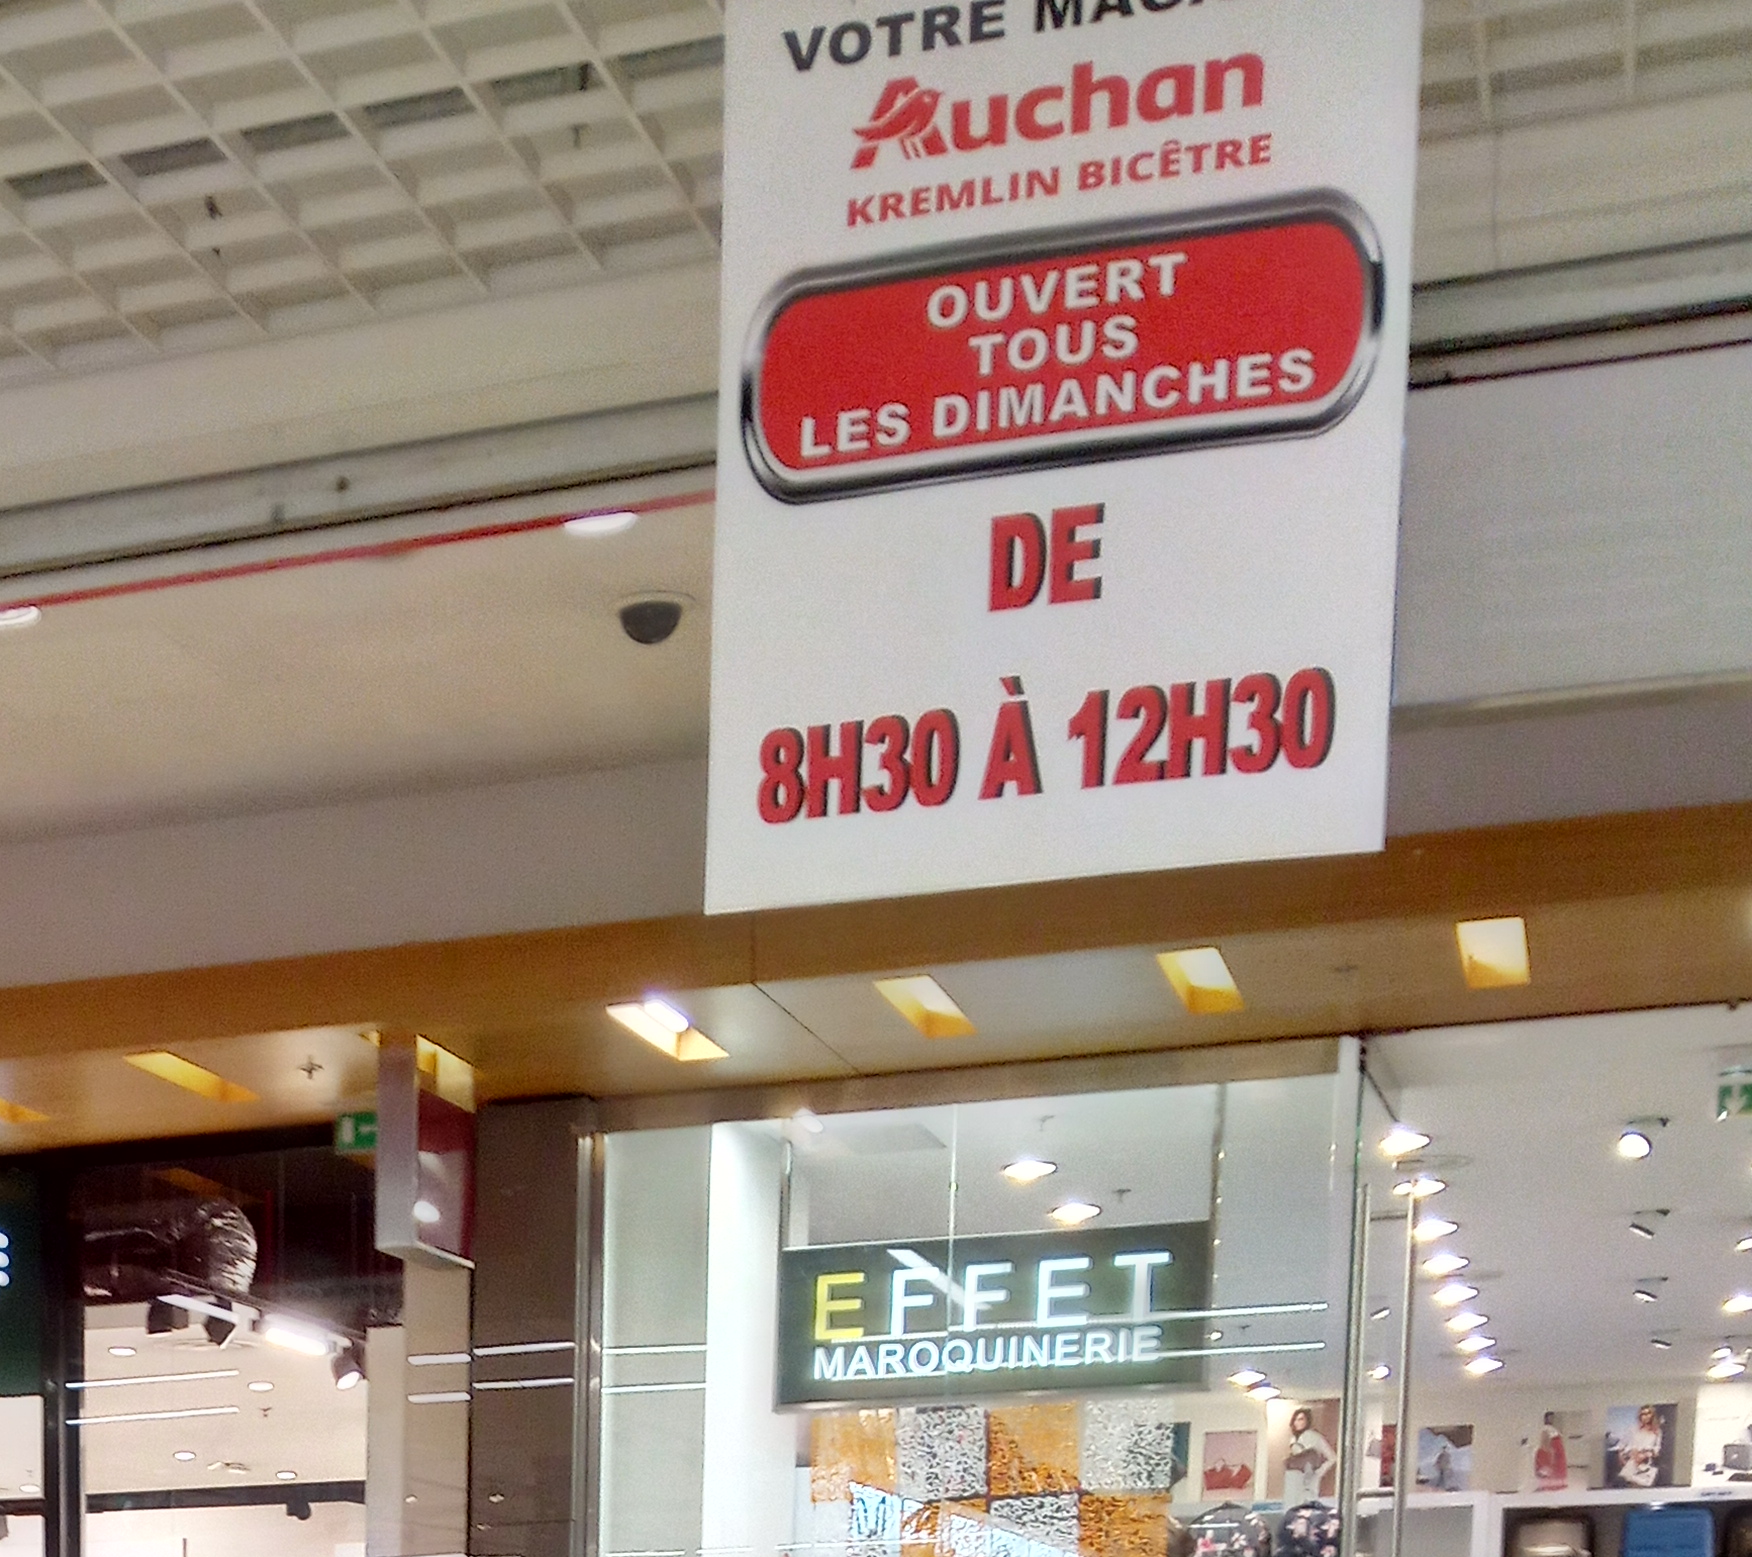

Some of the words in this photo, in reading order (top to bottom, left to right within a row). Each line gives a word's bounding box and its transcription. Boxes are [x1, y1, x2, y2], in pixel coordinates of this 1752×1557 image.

[783, 0, 1007, 73] VOTRE
[850, 52, 1266, 171] Auchan
[847, 167, 1061, 226] KREMLIN
[1079, 134, 1273, 192] BICÊTRE
[927, 252, 1187, 329] OUVERT
[969, 316, 1141, 375] TOUS
[799, 402, 912, 459] LES
[932, 349, 1318, 438] DIMANCHES
[987, 503, 1106, 613] DE
[756, 707, 960, 826] 8H30
[980, 676, 1043, 800] À
[1067, 666, 1337, 788] 12H30
[813, 1251, 1173, 1340] EFFET
[813, 1325, 1163, 1380] MAROQUINERIE
